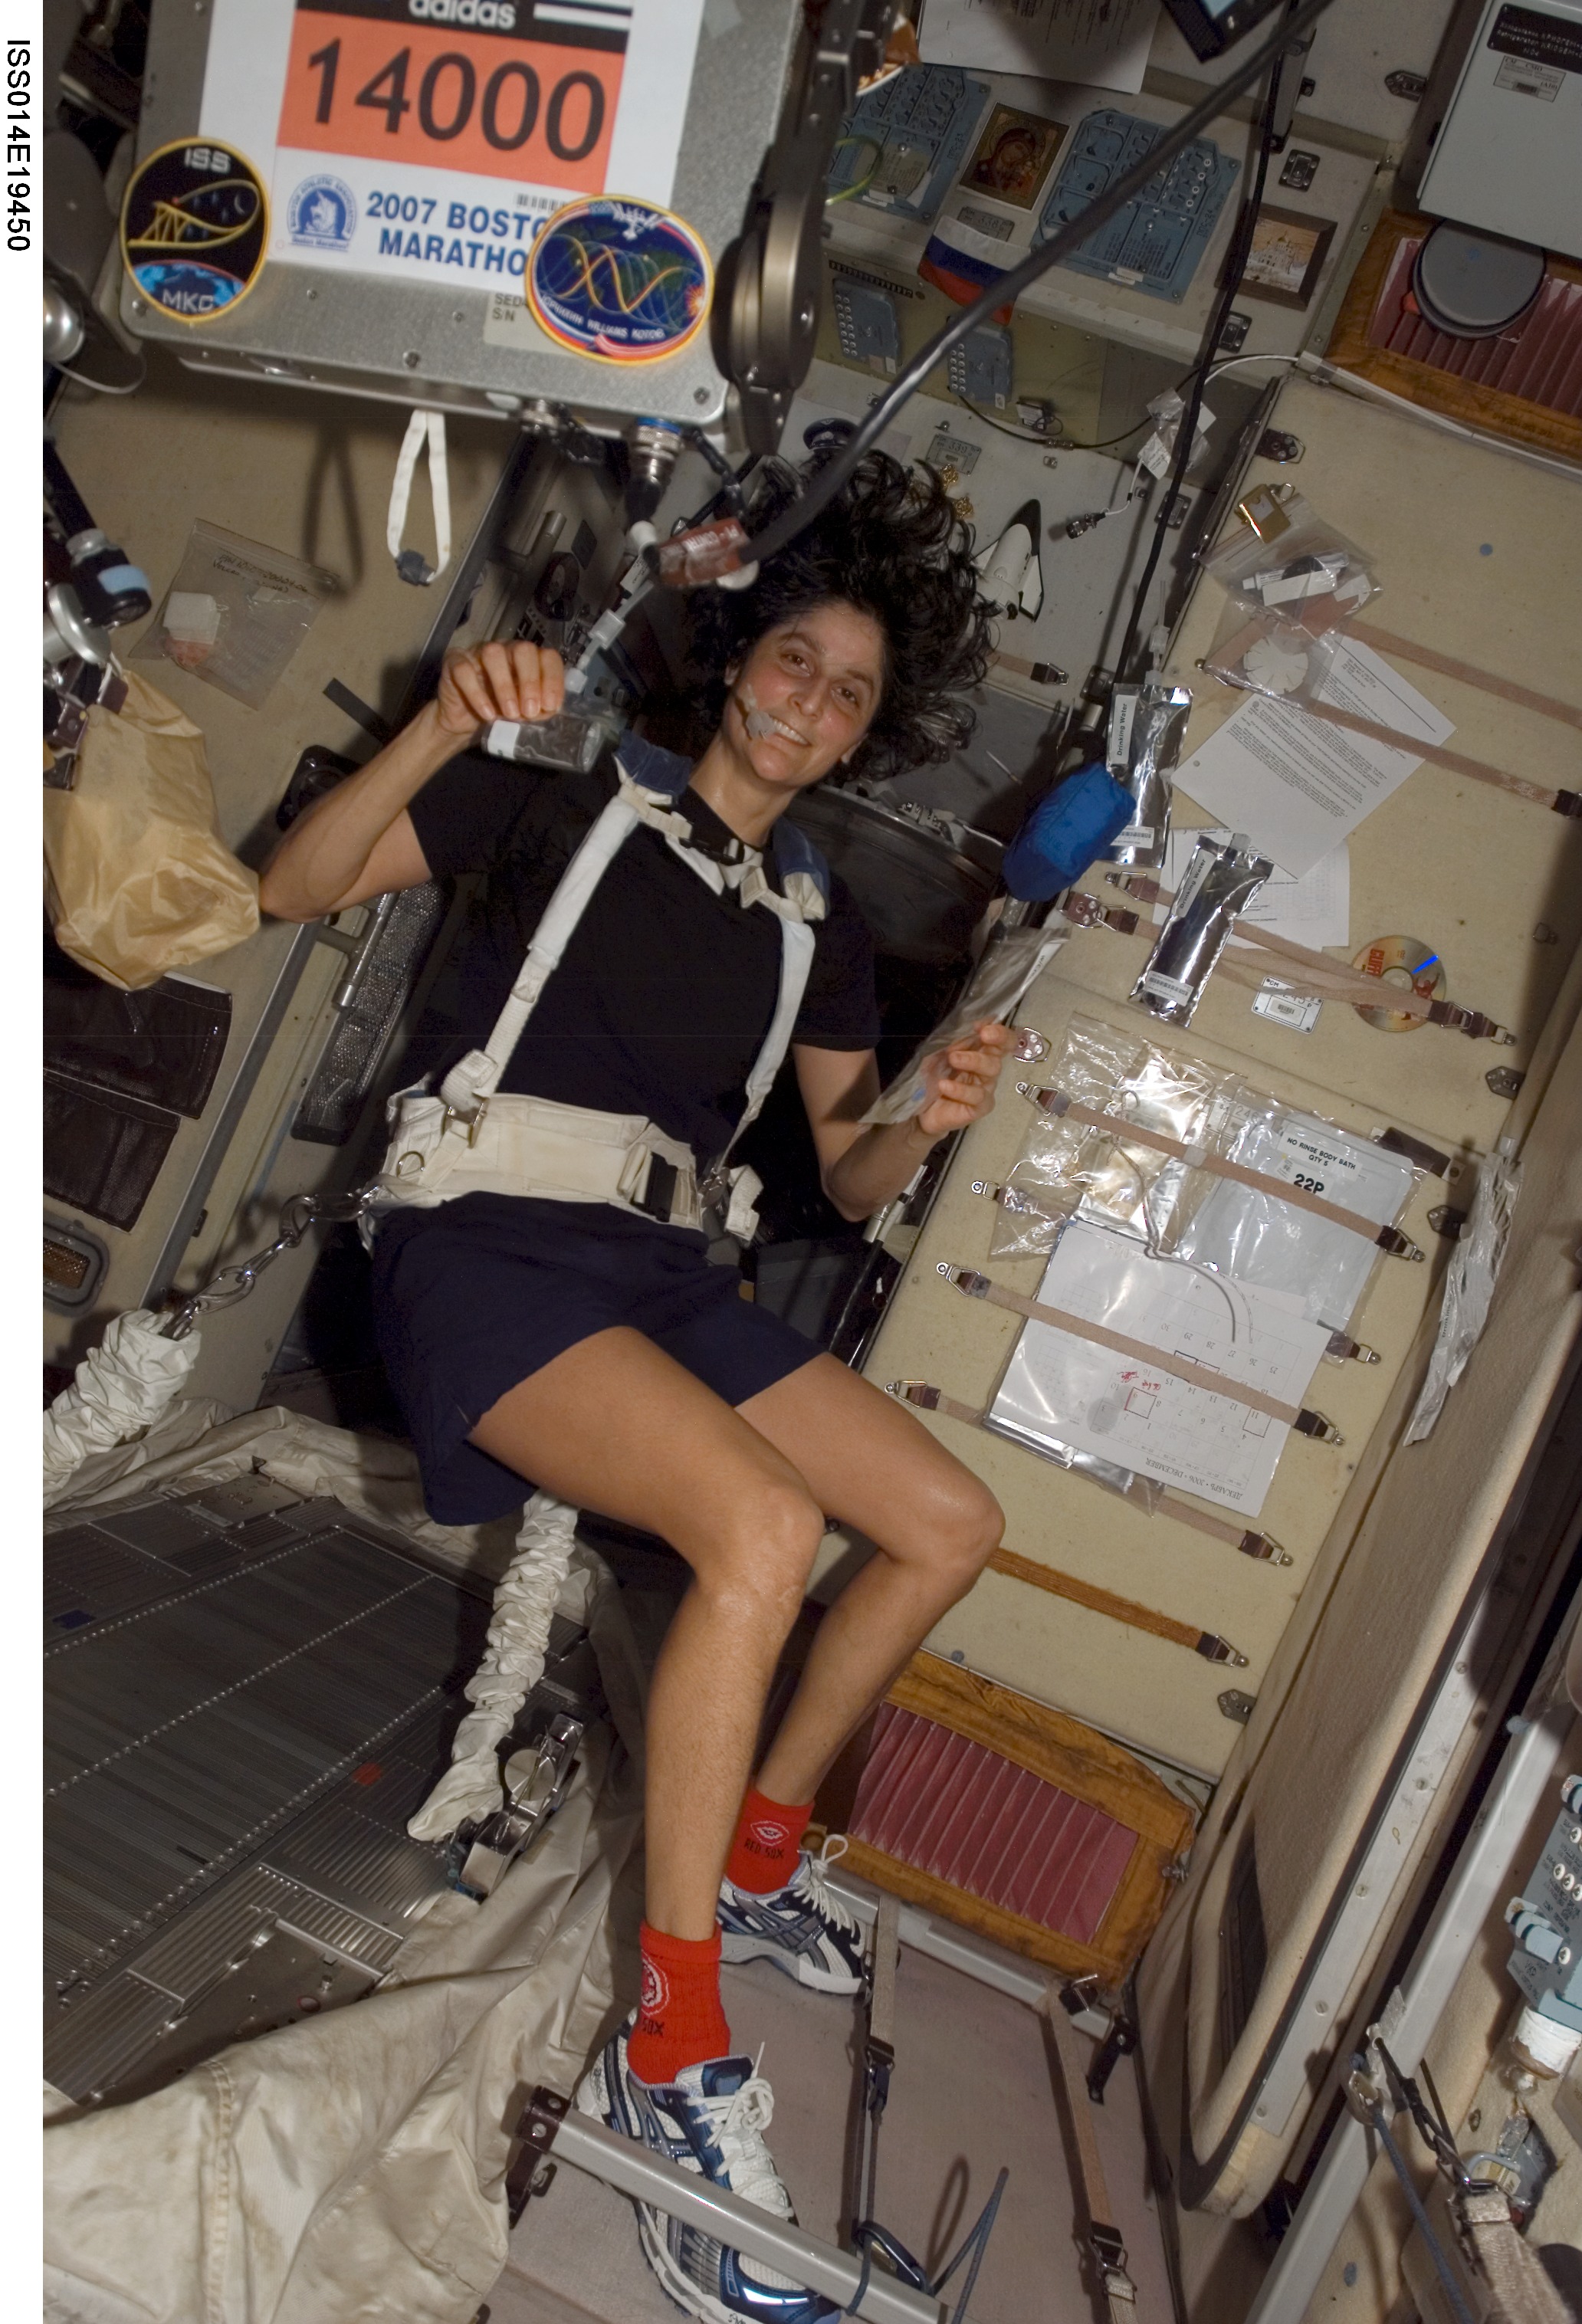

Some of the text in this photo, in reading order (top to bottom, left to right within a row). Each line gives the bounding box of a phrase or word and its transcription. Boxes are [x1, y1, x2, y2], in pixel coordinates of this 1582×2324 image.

[409, 0, 516, 29] adidas
[308, 37, 606, 162] 14000
[184, 148, 231, 173] ISS
[366, 190, 545, 241] 2007 BOSTO
[378, 227, 527, 277] MARATHO
[587, 318, 629, 338] WILLIAMS
[1116, 703, 1127, 756] Drinking Water
[1177, 858, 1206, 909] Drinking Water
[1286, 1137, 1357, 1170] NO RINSE BODY BATH
[1308, 1154, 1322, 1164] QTY
[1292, 1171, 1327, 1196] 22P
[1160, 1321, 1171, 1331] 30
[1183, 1331, 1193, 1341] 29
[1205, 1340, 1216, 1349] 28
[1226, 1348, 1236, 1358] 27
[1248, 1357, 1258, 1366] 26
[1269, 1365, 1278, 1374] 25
[1110, 1381, 1119, 1391] 10
[1141, 1367, 1259, 1419] 11 12 13 14 15 16
[1154, 1399, 1161, 1408] 8
[1177, 1408, 1183, 1416] 7
[1199, 1416, 1206, 1425] 6
[1219, 1424, 1226, 1433] 5
[1144, 1458, 1242, 1500] ДЕКАБРЬ 2006 DECEMBER
[743, 1837, 786, 1861] RED SOX
